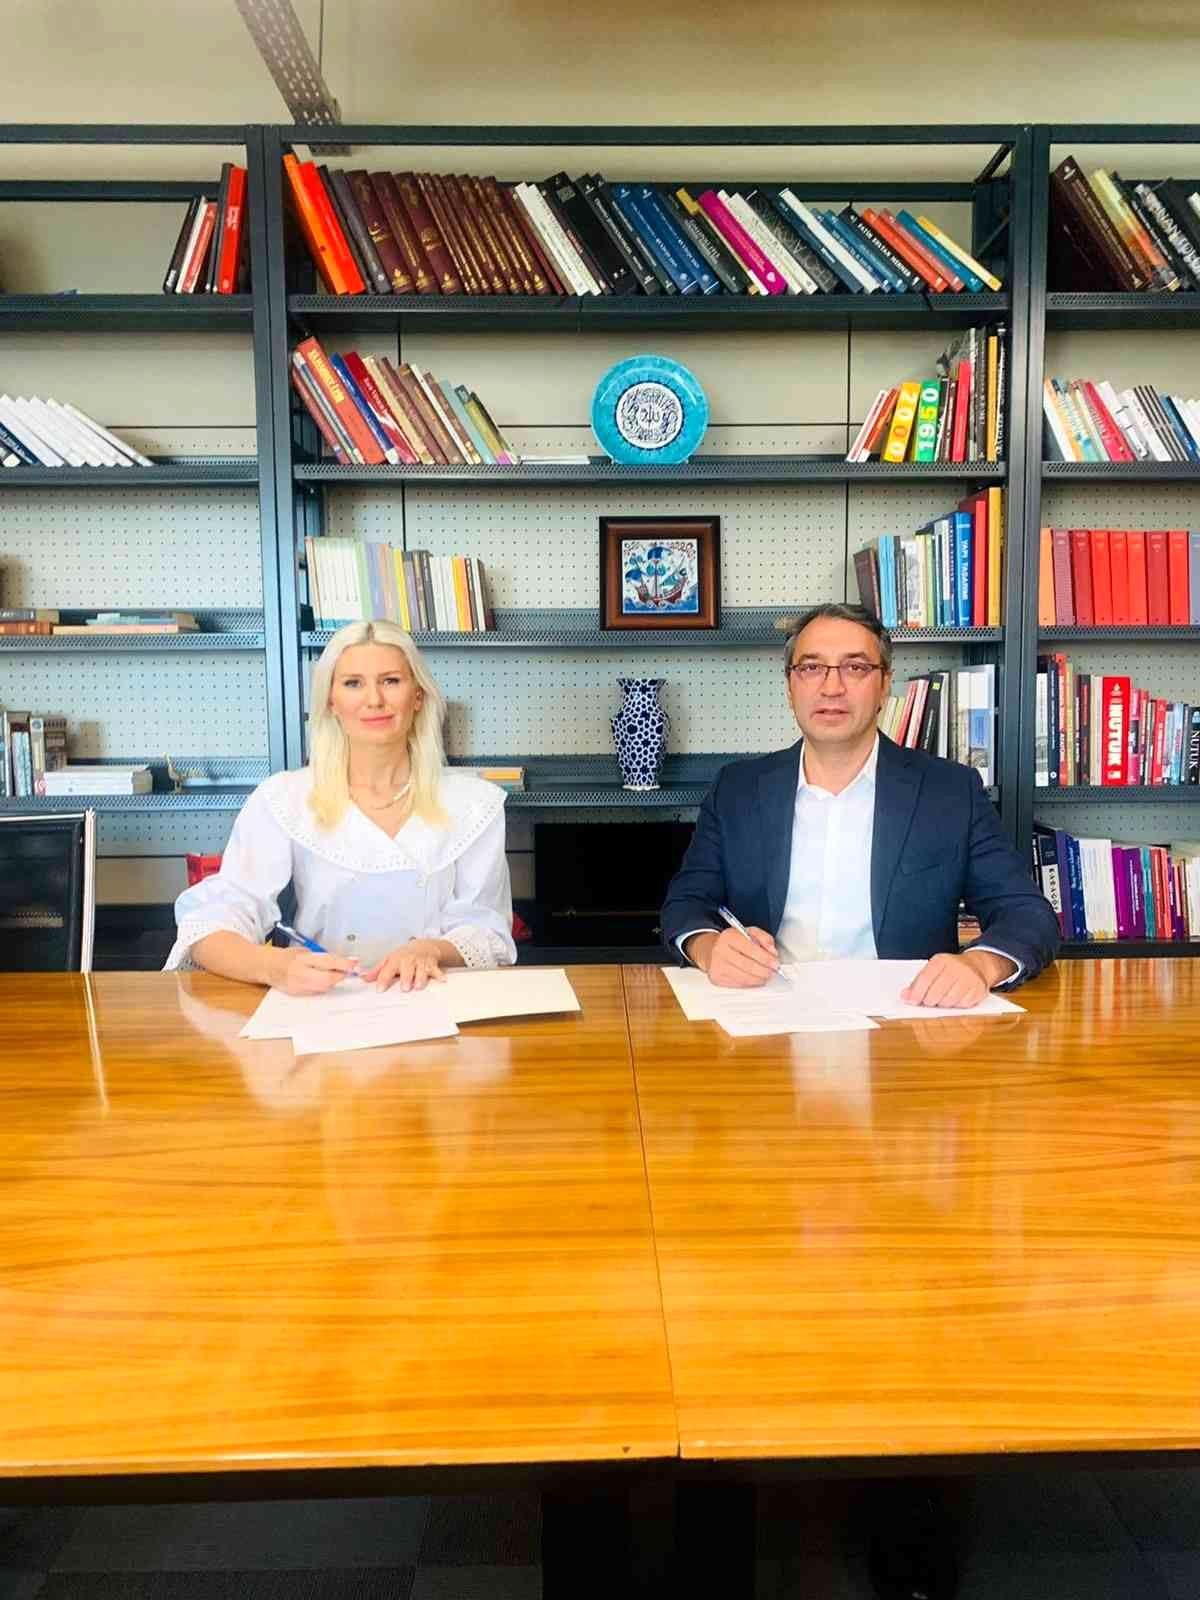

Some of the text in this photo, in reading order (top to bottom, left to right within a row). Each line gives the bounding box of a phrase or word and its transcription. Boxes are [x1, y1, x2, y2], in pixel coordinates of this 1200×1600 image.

[917, 387, 939, 450] 1950
[1107, 703, 1123, 767] NUTUK
[1188, 731, 1200, 769] NUTUK
